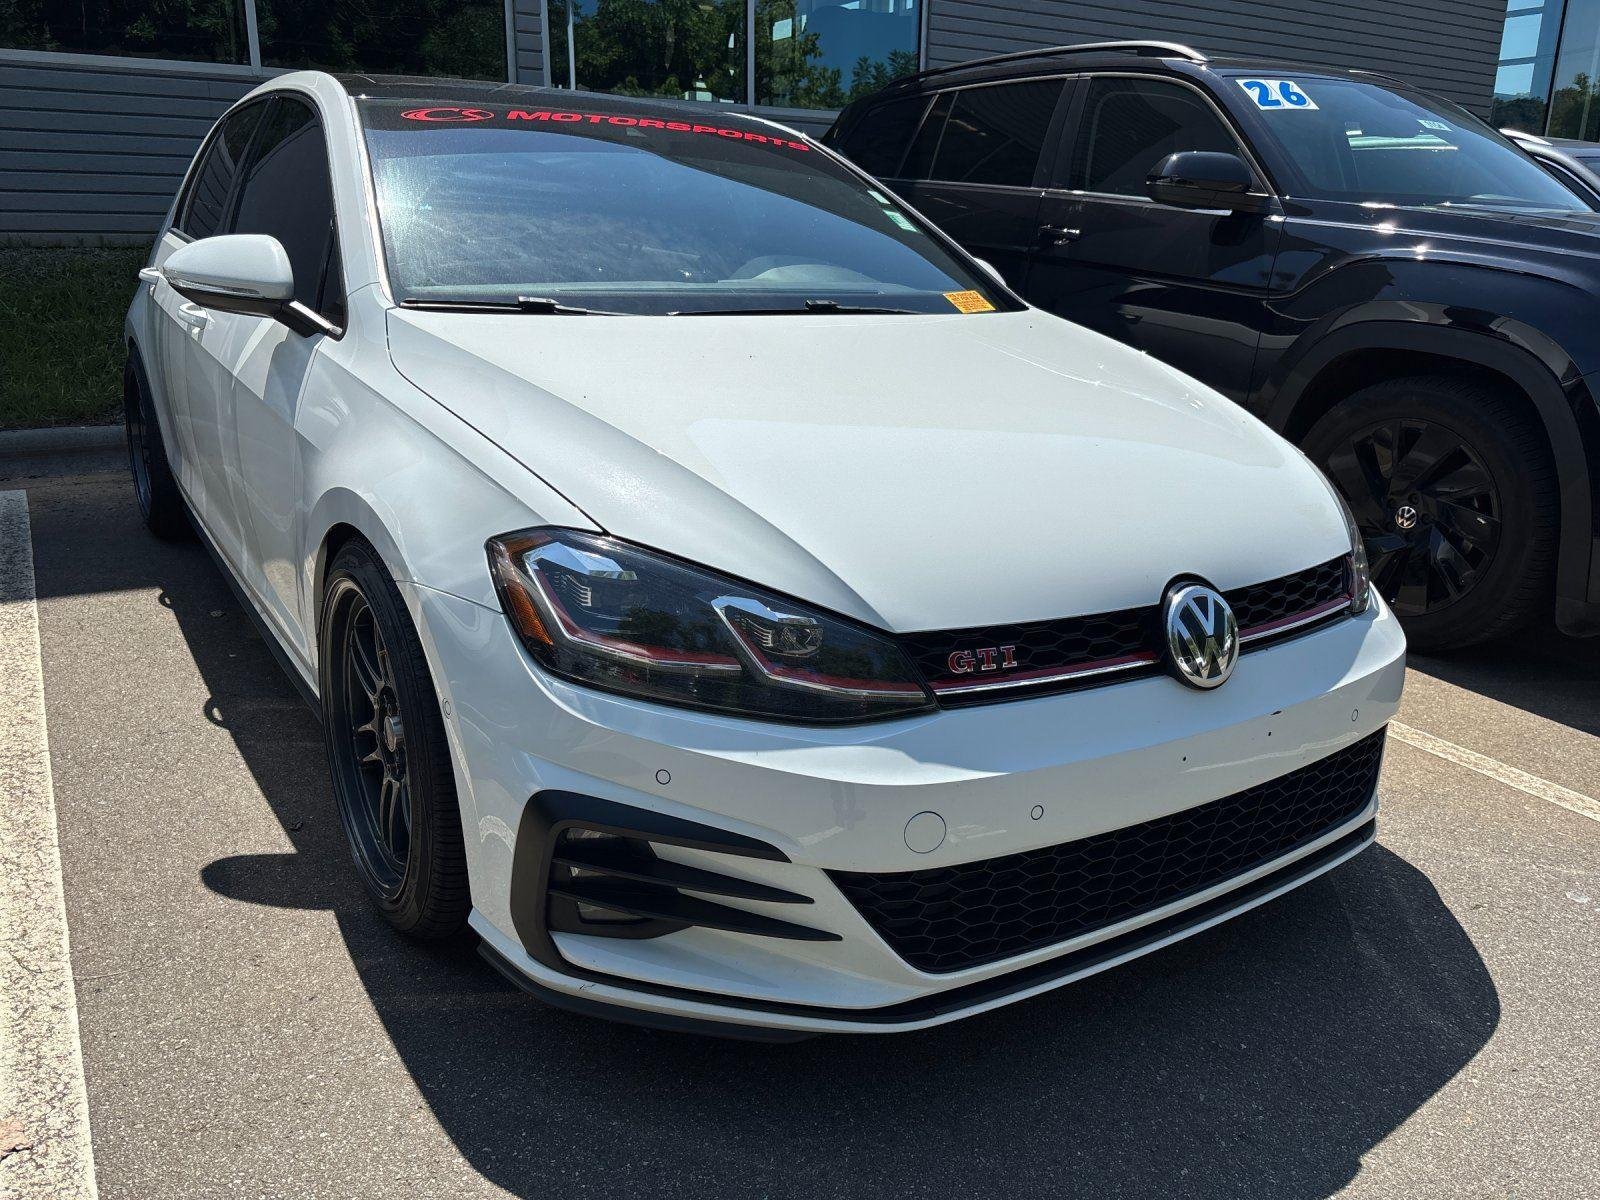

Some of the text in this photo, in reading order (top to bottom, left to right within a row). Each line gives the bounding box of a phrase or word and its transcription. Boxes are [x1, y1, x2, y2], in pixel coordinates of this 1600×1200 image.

[1243, 81, 1307, 107] 26
[507, 110, 809, 151] MOTORSPORTS
[1167, 585, 1239, 688] VW
[948, 645, 1017, 674] GTI
